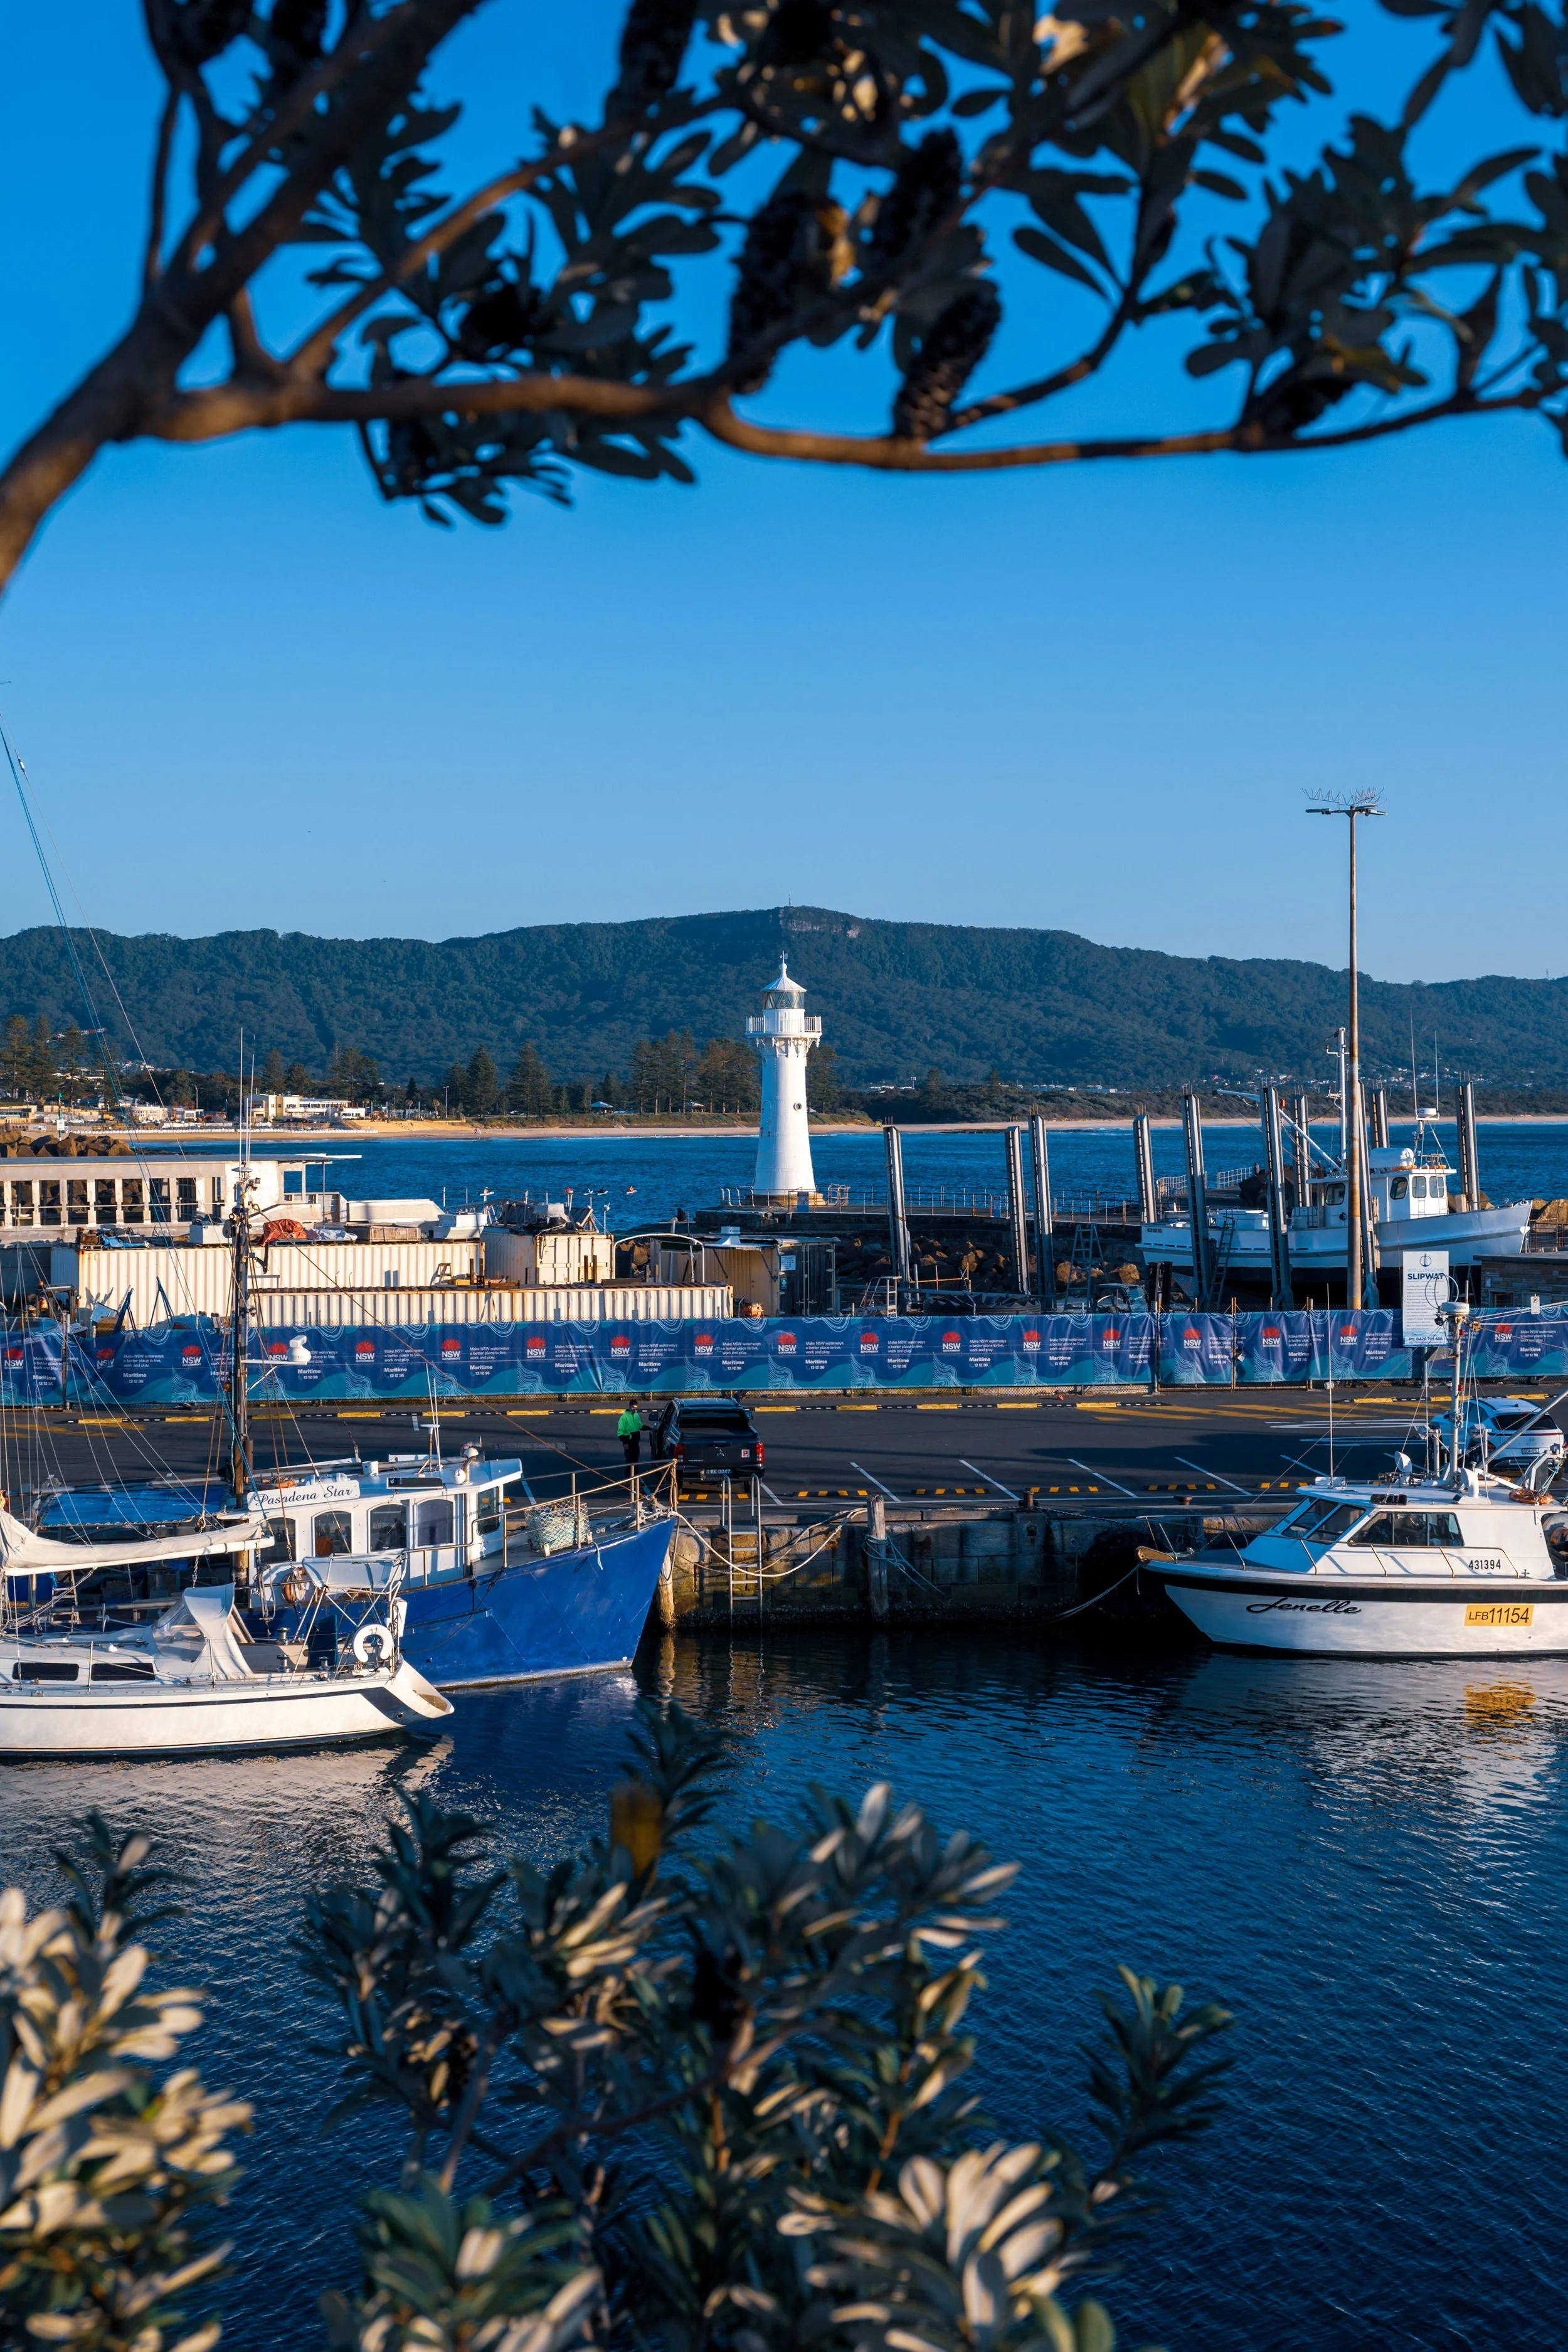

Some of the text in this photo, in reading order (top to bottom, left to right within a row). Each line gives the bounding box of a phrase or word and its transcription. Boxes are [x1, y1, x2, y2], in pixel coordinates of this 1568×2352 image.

[254, 1486, 353, 1506] Pasadena Star
[1468, 1559, 1501, 1570] 431394
[1246, 1597, 1362, 1614] Jenelle
